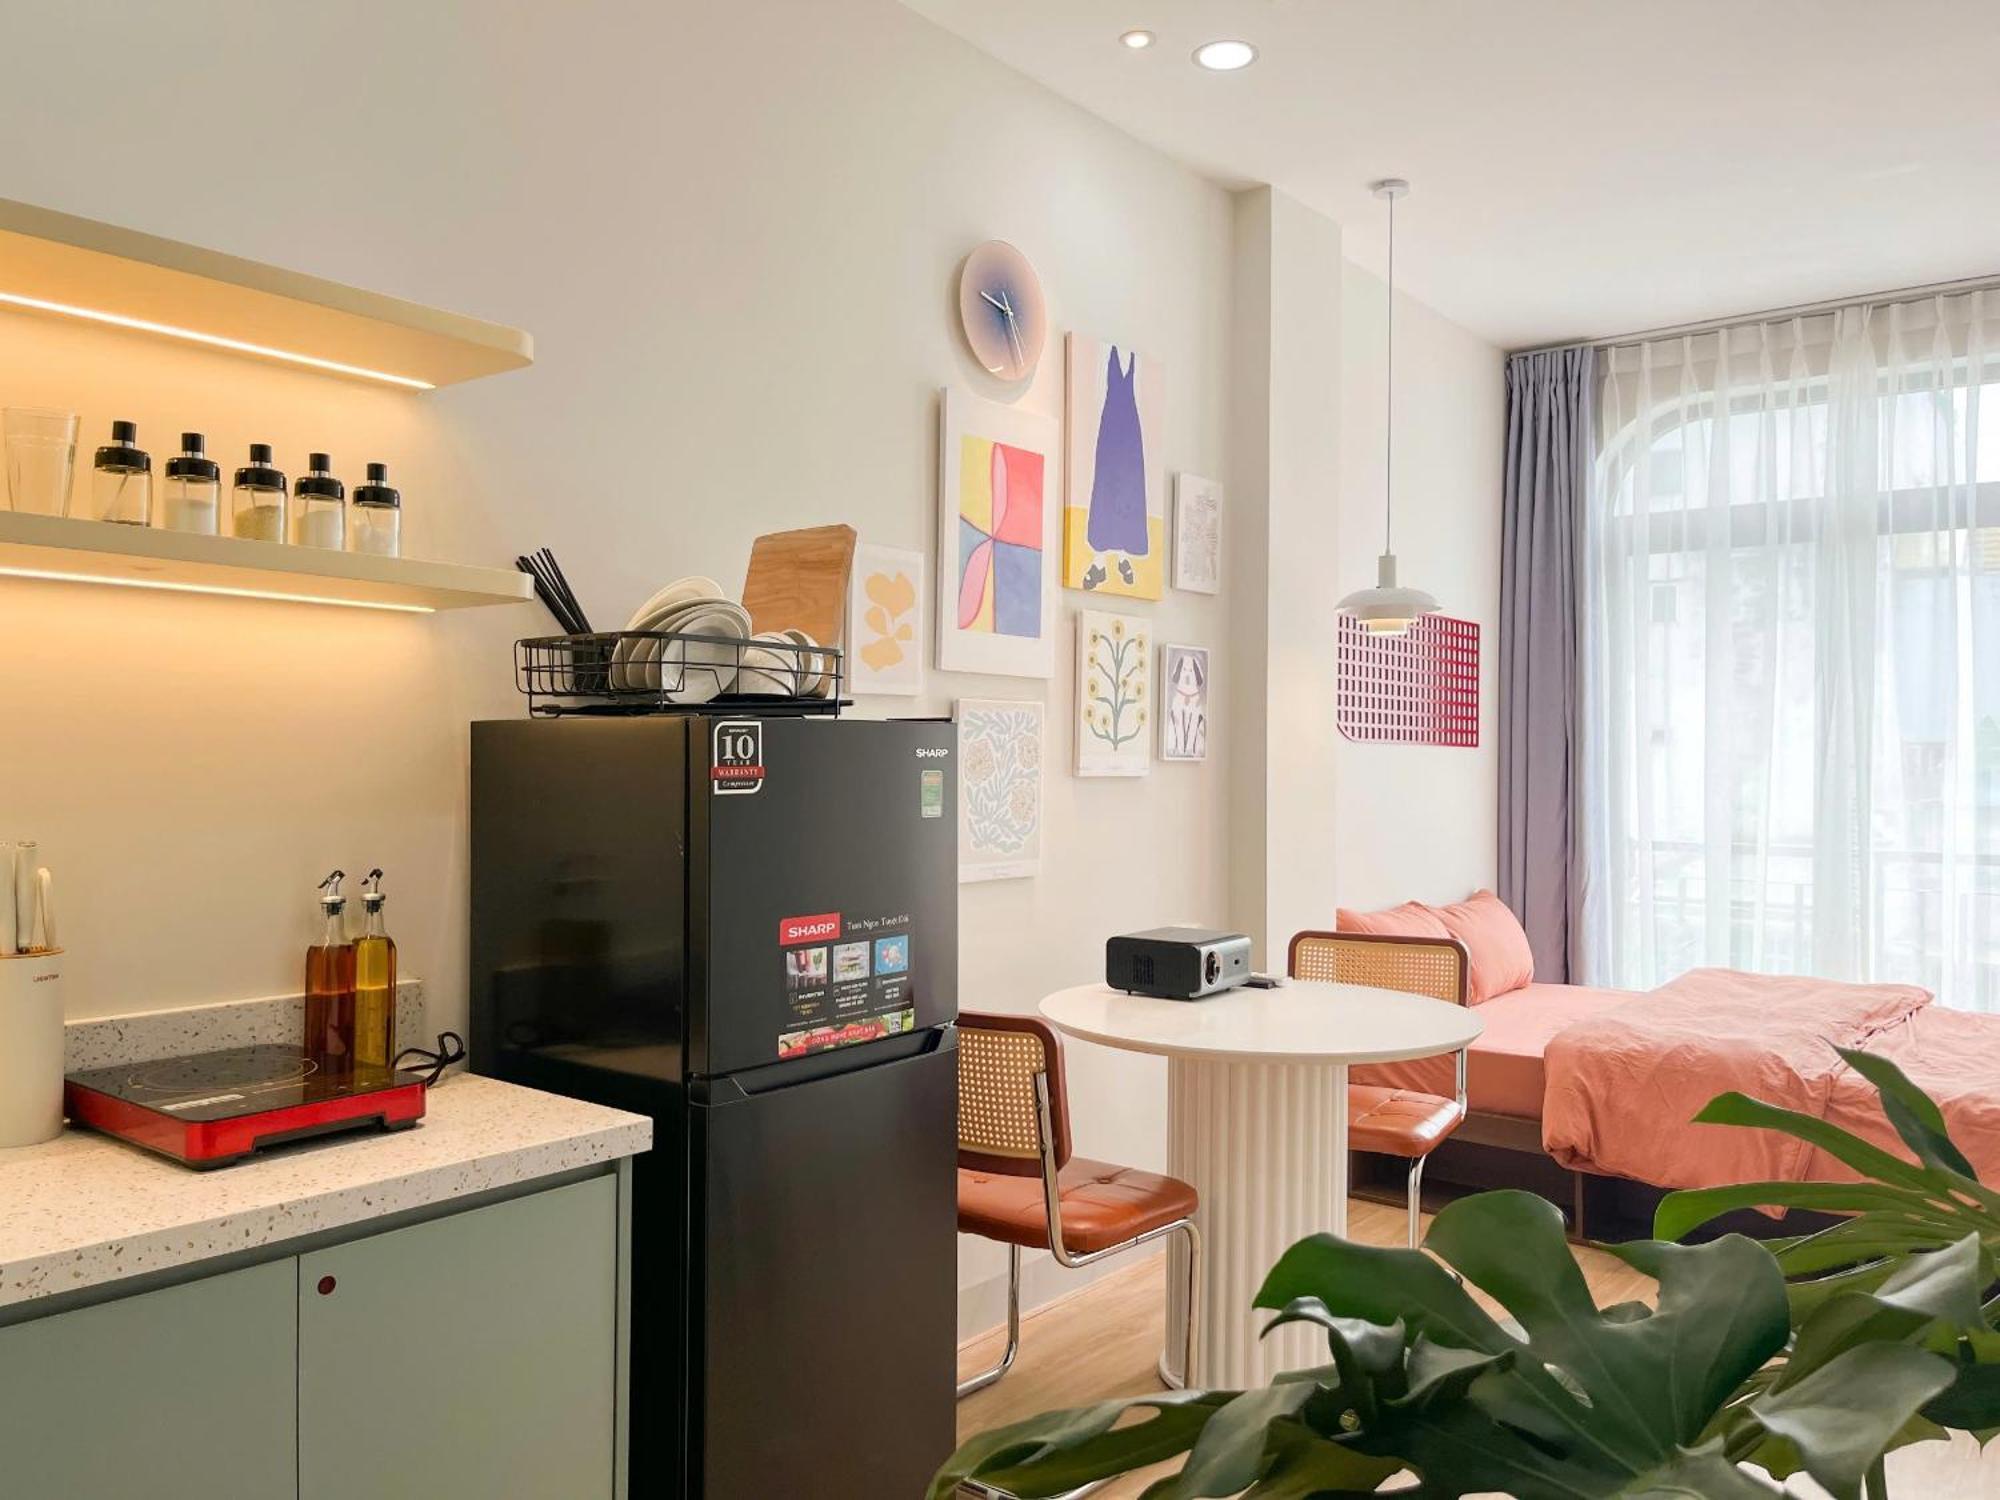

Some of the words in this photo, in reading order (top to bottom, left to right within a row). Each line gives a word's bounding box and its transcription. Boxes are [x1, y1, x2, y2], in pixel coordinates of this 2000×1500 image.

[721, 734, 755, 760] 10
[916, 748, 949, 758] SHARP
[788, 923, 836, 938] SHARP
